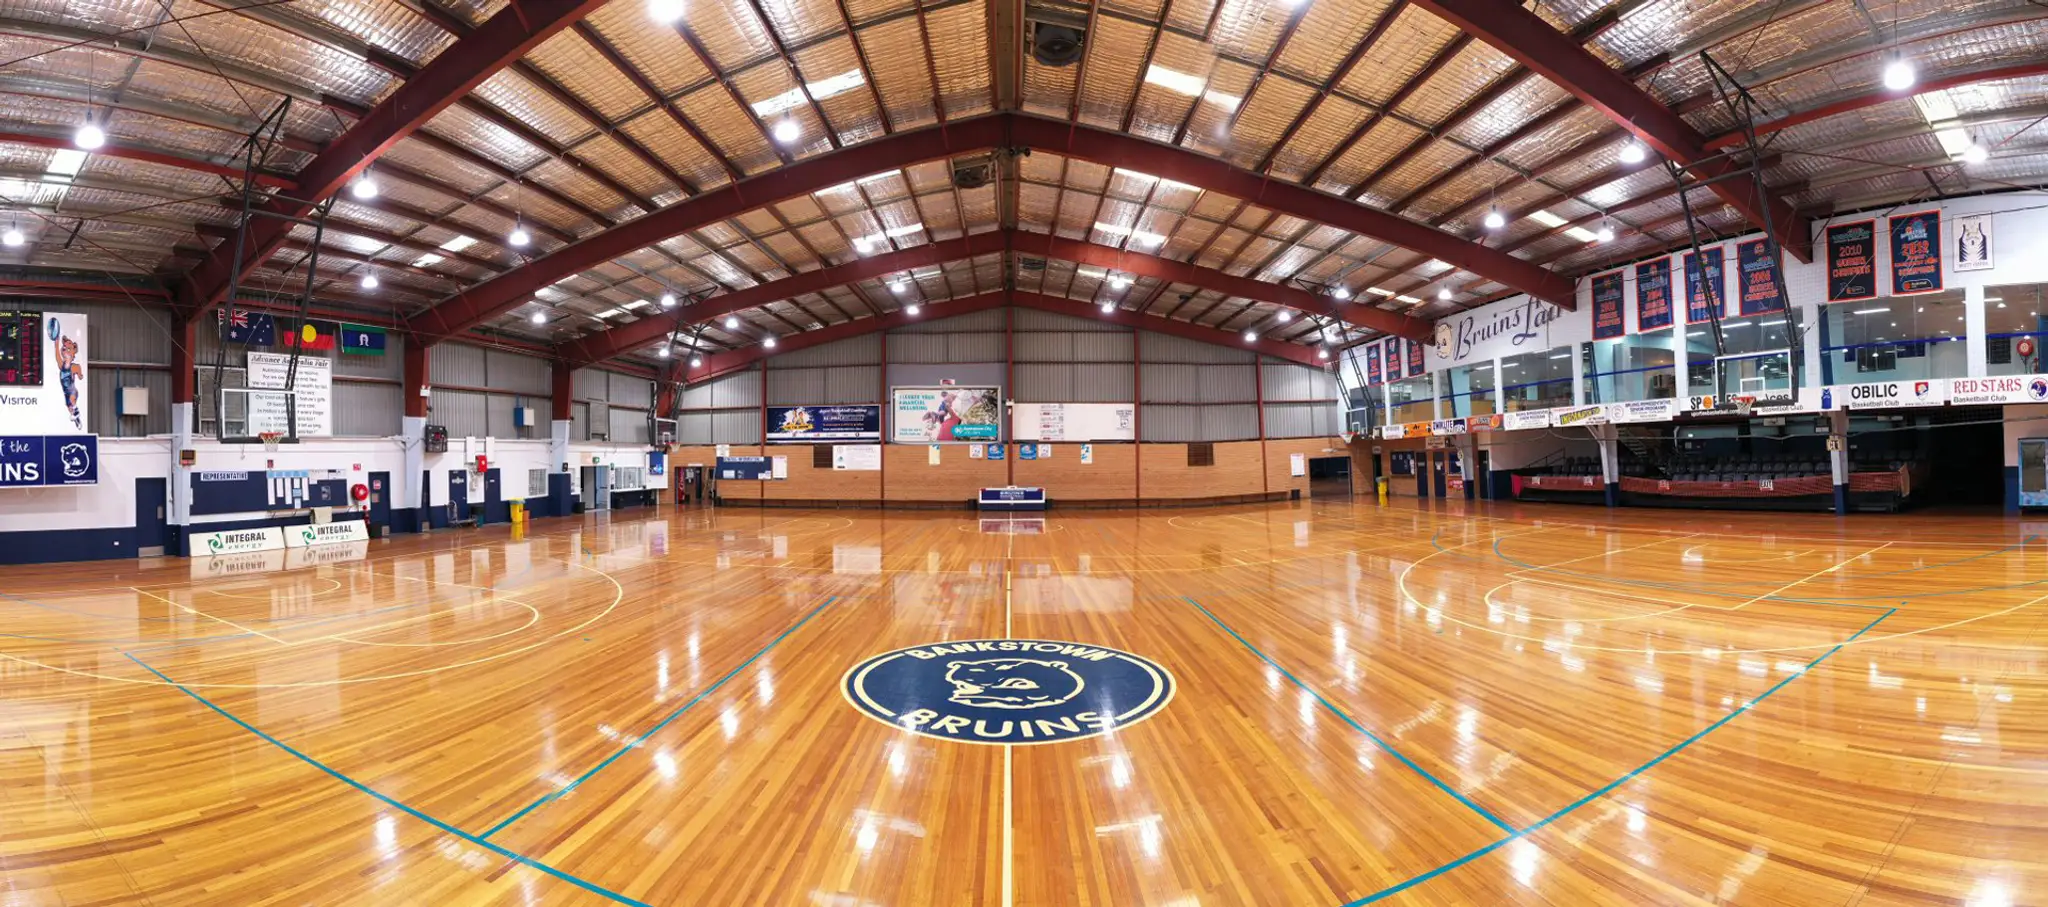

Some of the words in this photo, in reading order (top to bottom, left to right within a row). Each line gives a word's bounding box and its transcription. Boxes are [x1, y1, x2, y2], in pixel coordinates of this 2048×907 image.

[1839, 244, 1863, 258] 2010
[1453, 310, 1521, 361] Bruins
[1851, 383, 1898, 399] OBILIC
[1953, 380, 1978, 394] RED
[1980, 377, 2022, 392] STARS
[1852, 400, 1883, 408] Basketball
[1953, 395, 1989, 403] Basketball
[1991, 394, 2008, 402] Club
[10, 440, 30, 453] the
[202, 472, 248, 480] REPRESENTATIVE
[317, 525, 353, 536] INTEGRAL
[225, 532, 266, 544] INTEGRAL
[905, 641, 1116, 662] BANKSTOWN
[901, 708, 1108, 738] BRUINS
